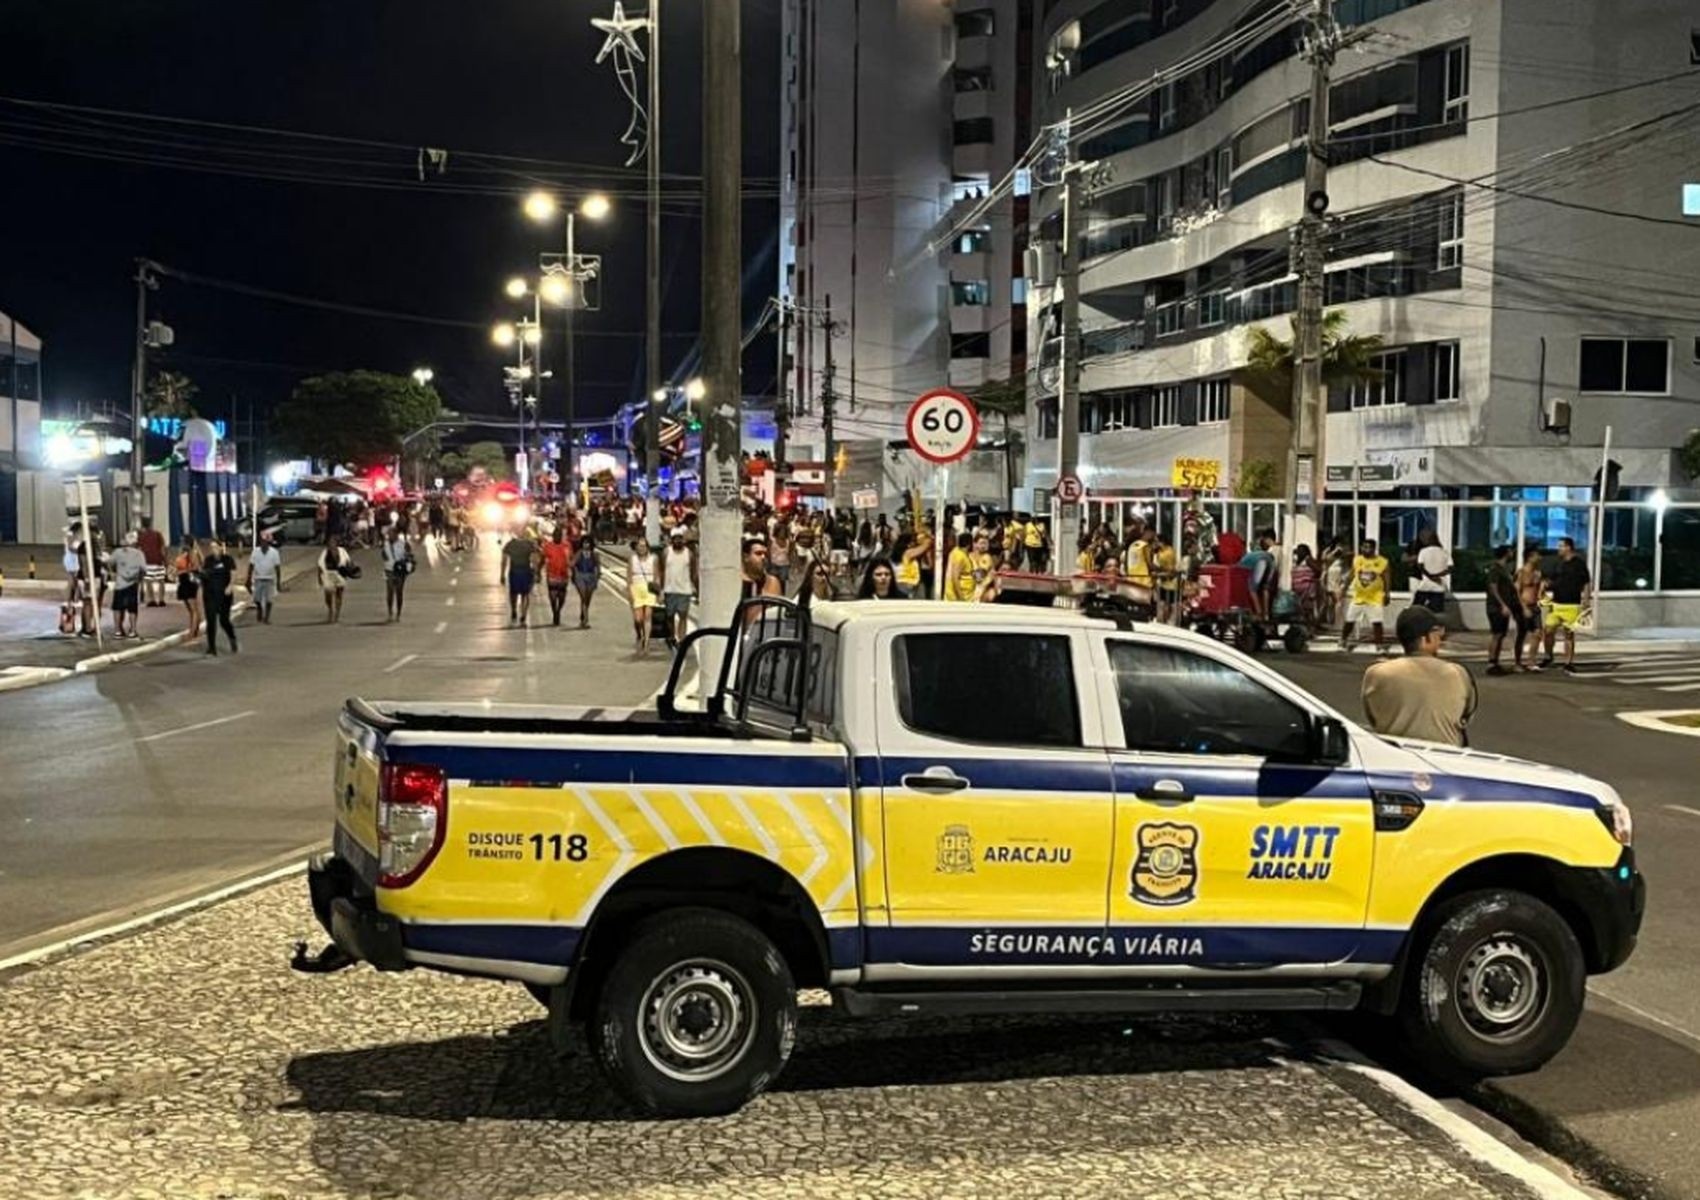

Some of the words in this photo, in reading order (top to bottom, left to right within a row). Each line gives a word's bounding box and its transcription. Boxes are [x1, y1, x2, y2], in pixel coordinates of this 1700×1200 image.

[922, 407, 963, 433] 60
[468, 833, 524, 846] DISQUE
[529, 833, 588, 862] 118
[1250, 825, 1341, 858] SMTT
[468, 848, 523, 860] TRÂNSITO
[984, 846, 1072, 863] ARACAJU
[1246, 862, 1331, 880] ARACAJU
[970, 934, 1116, 957] SEGURANÇA
[1124, 933, 1204, 955] VIÁRIA
